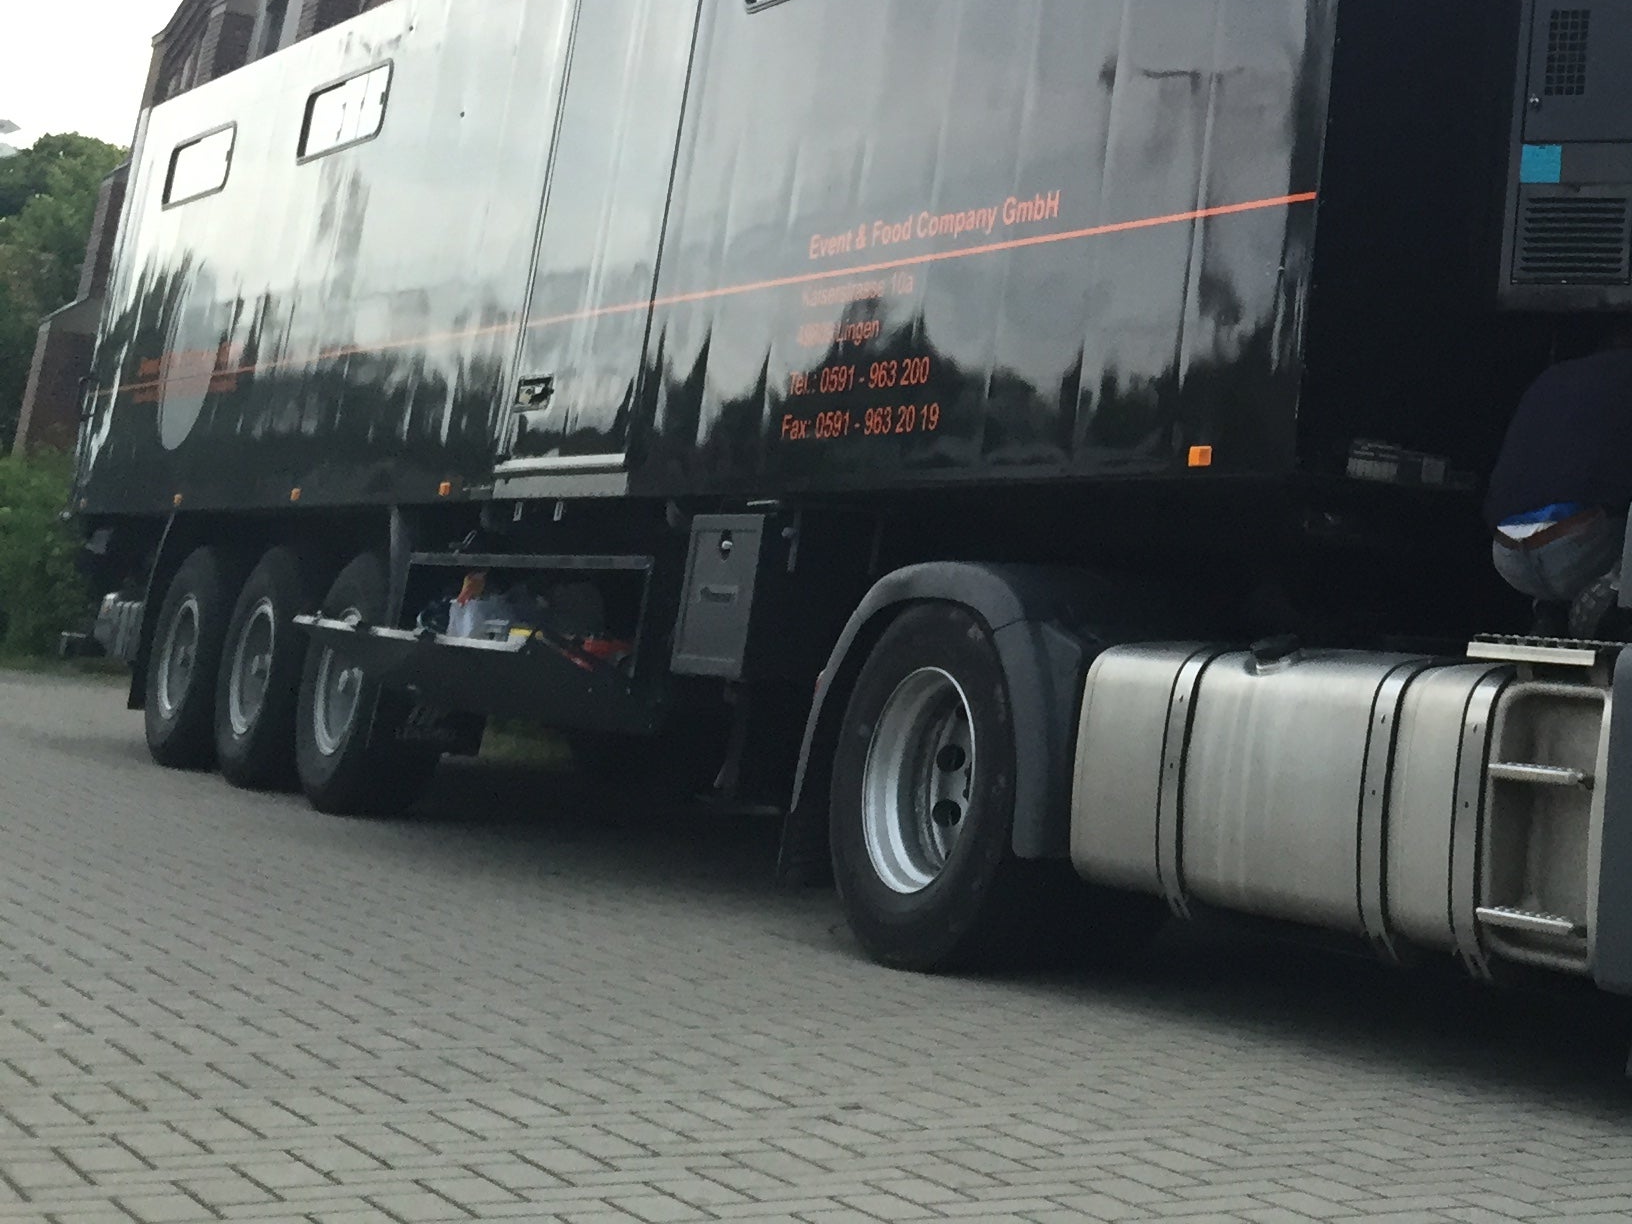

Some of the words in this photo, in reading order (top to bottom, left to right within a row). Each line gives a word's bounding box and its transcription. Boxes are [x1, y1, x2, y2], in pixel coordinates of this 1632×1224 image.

[809, 230, 852, 260] Event
[855, 224, 867, 250] &
[872, 215, 913, 247] Food
[916, 205, 998, 239] Company
[1002, 189, 1062, 225] GmbH
[835, 319, 880, 346] Lingen
[820, 364, 855, 394] 0591
[868, 360, 898, 389] 963
[900, 356, 930, 386] 200
[781, 414, 812, 440] Fax:
[815, 410, 850, 439] 0591
[864, 406, 892, 436] 963
[895, 404, 916, 433] 20
[920, 402, 940, 431] 19
